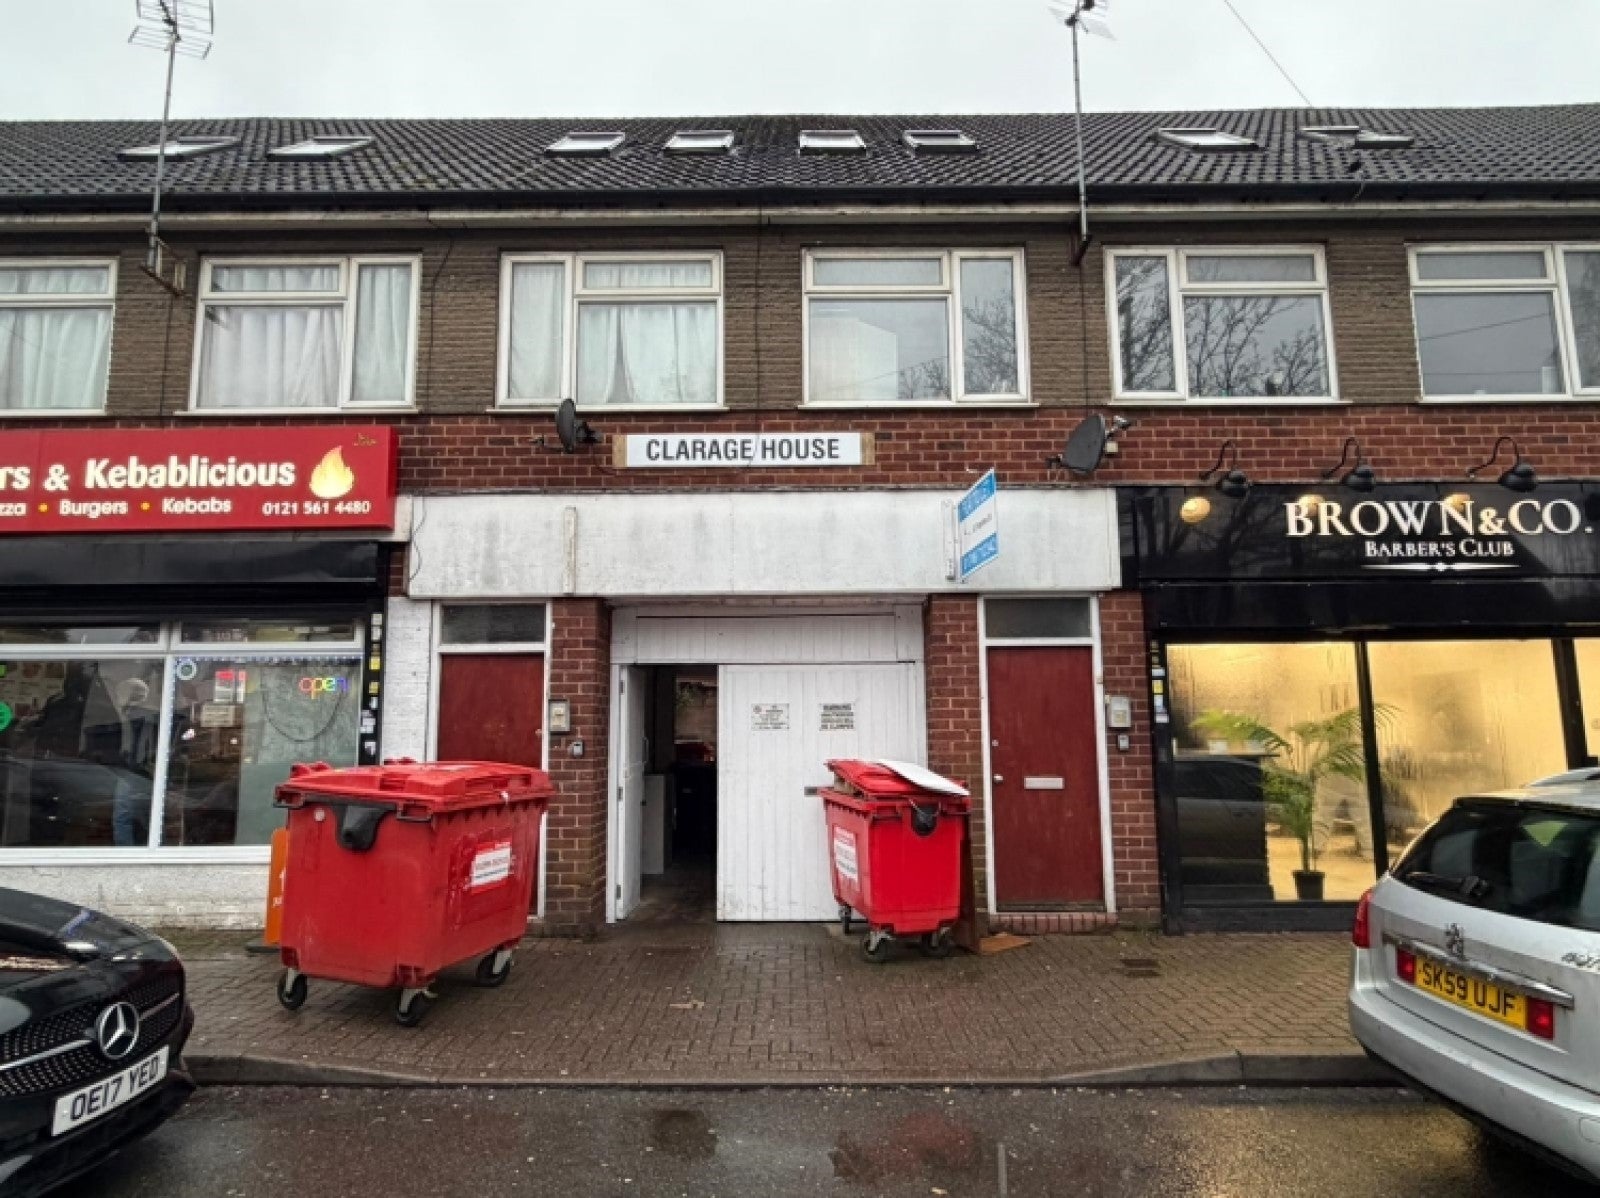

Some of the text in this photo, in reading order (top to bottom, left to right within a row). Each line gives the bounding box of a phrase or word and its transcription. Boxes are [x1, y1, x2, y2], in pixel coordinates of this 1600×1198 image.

[646, 438, 841, 461] CLARAGE HOUSE
[43, 464, 69, 490] &
[84, 456, 296, 489] Kebablicious
[59, 499, 129, 519] Burgers
[161, 497, 232, 515] Kebabs
[262, 501, 296, 516] 0121
[303, 501, 330, 515] 561
[334, 500, 371, 515] 4480
[299, 676, 347, 700] open
[1422, 962, 1516, 1017] SK59 UJF
[70, 1055, 160, 1121] OE17 YED
